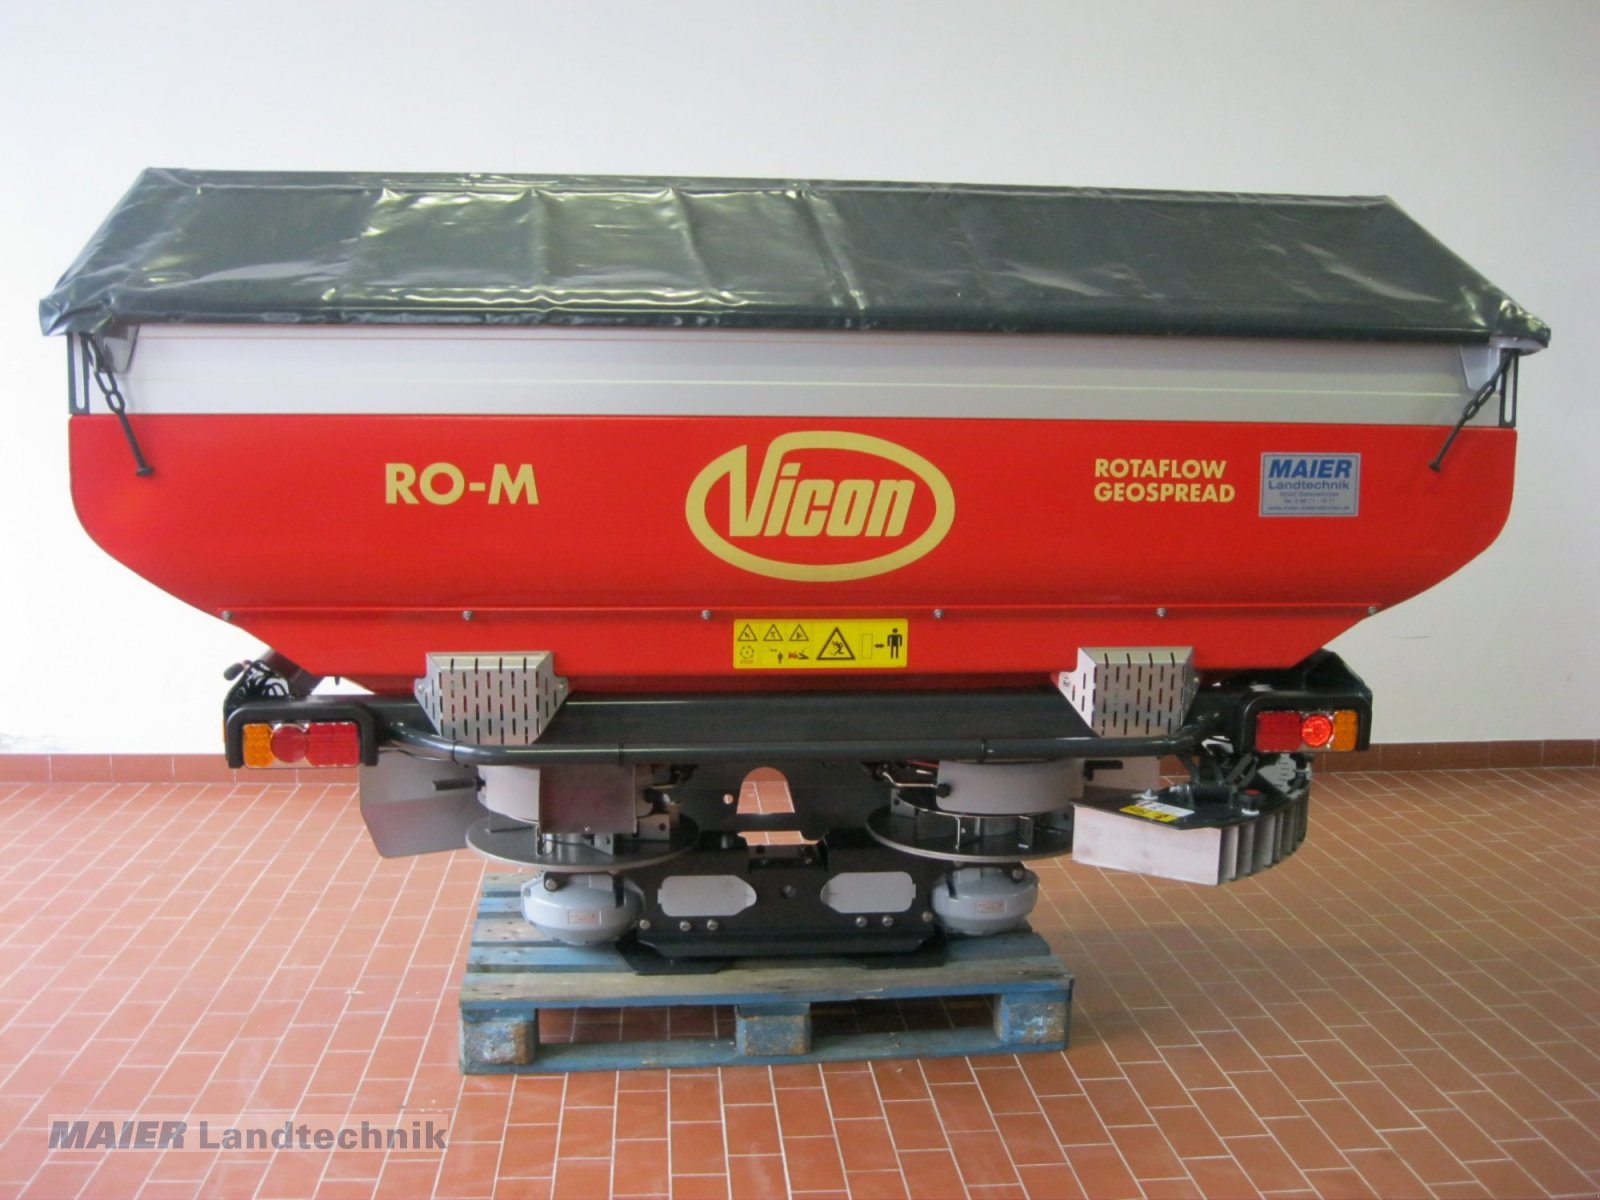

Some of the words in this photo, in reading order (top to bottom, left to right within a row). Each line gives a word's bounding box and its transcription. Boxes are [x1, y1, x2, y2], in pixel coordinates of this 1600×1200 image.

[1094, 458, 1227, 479] ROTAFLOW
[1268, 458, 1353, 478] MAIER
[385, 462, 539, 505] RO-M
[729, 440, 916, 537] Vicon
[1093, 482, 1236, 503] GEOSPREAD
[1268, 480, 1350, 490] Landtechnik
